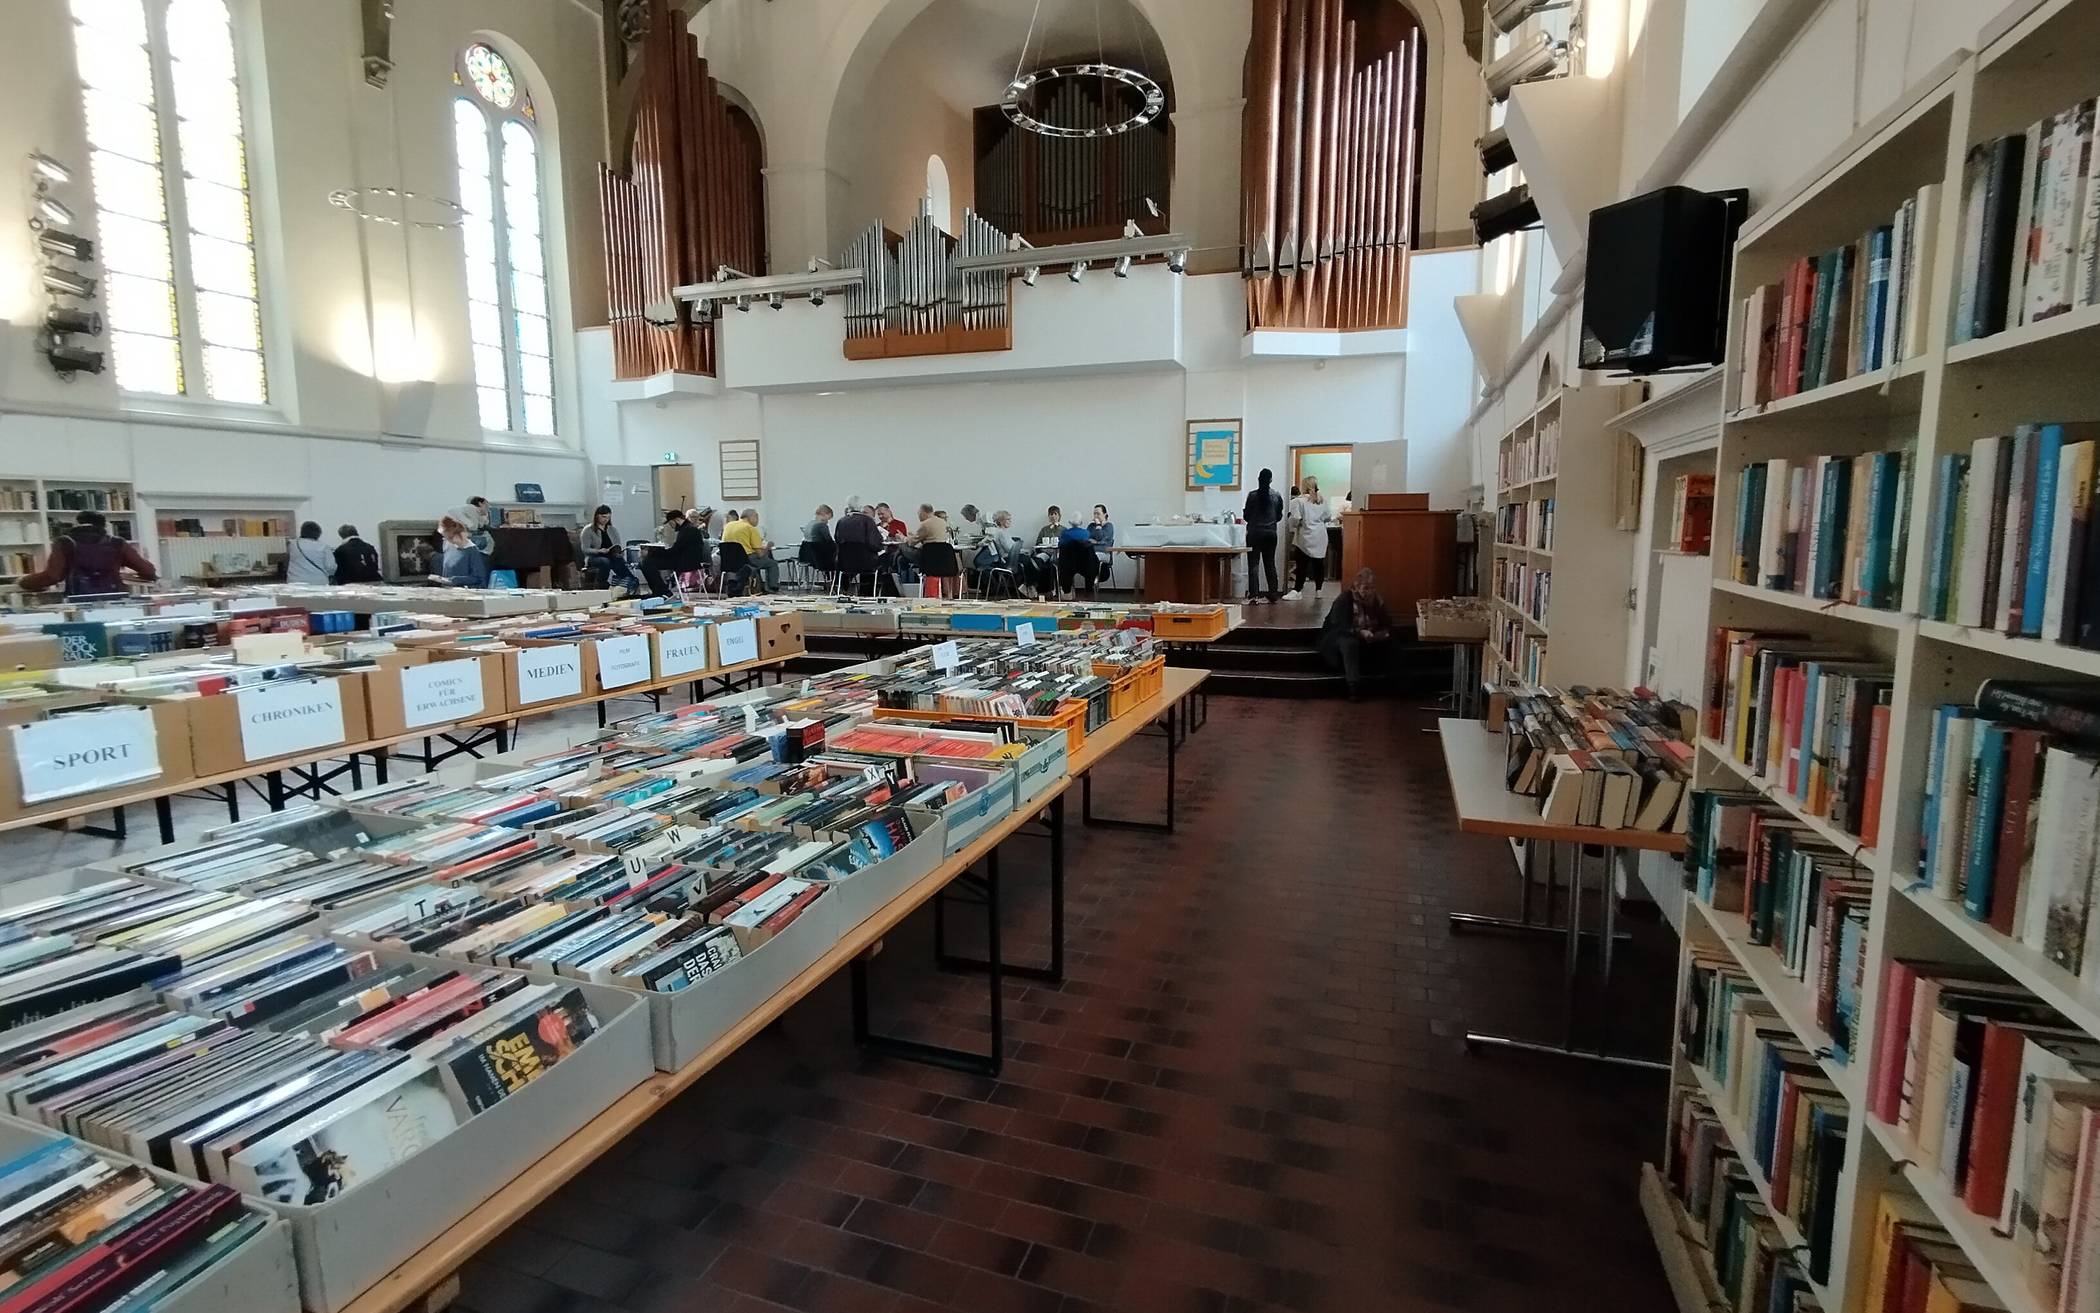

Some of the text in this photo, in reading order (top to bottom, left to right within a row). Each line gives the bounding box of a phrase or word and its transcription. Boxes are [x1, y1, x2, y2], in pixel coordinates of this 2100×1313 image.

[63, 635, 89, 645] DER
[666, 645, 701, 660] FRAUEN
[527, 663, 576, 679] MEDIEN
[251, 701, 335, 724] CHRONIKEN
[53, 743, 132, 770] SPORT
[868, 769, 877, 780] X
[887, 772, 895, 785] Y
[667, 829, 681, 844] W
[630, 857, 640, 873] U
[414, 899, 426, 917] T
[696, 952, 713, 978] DAS
